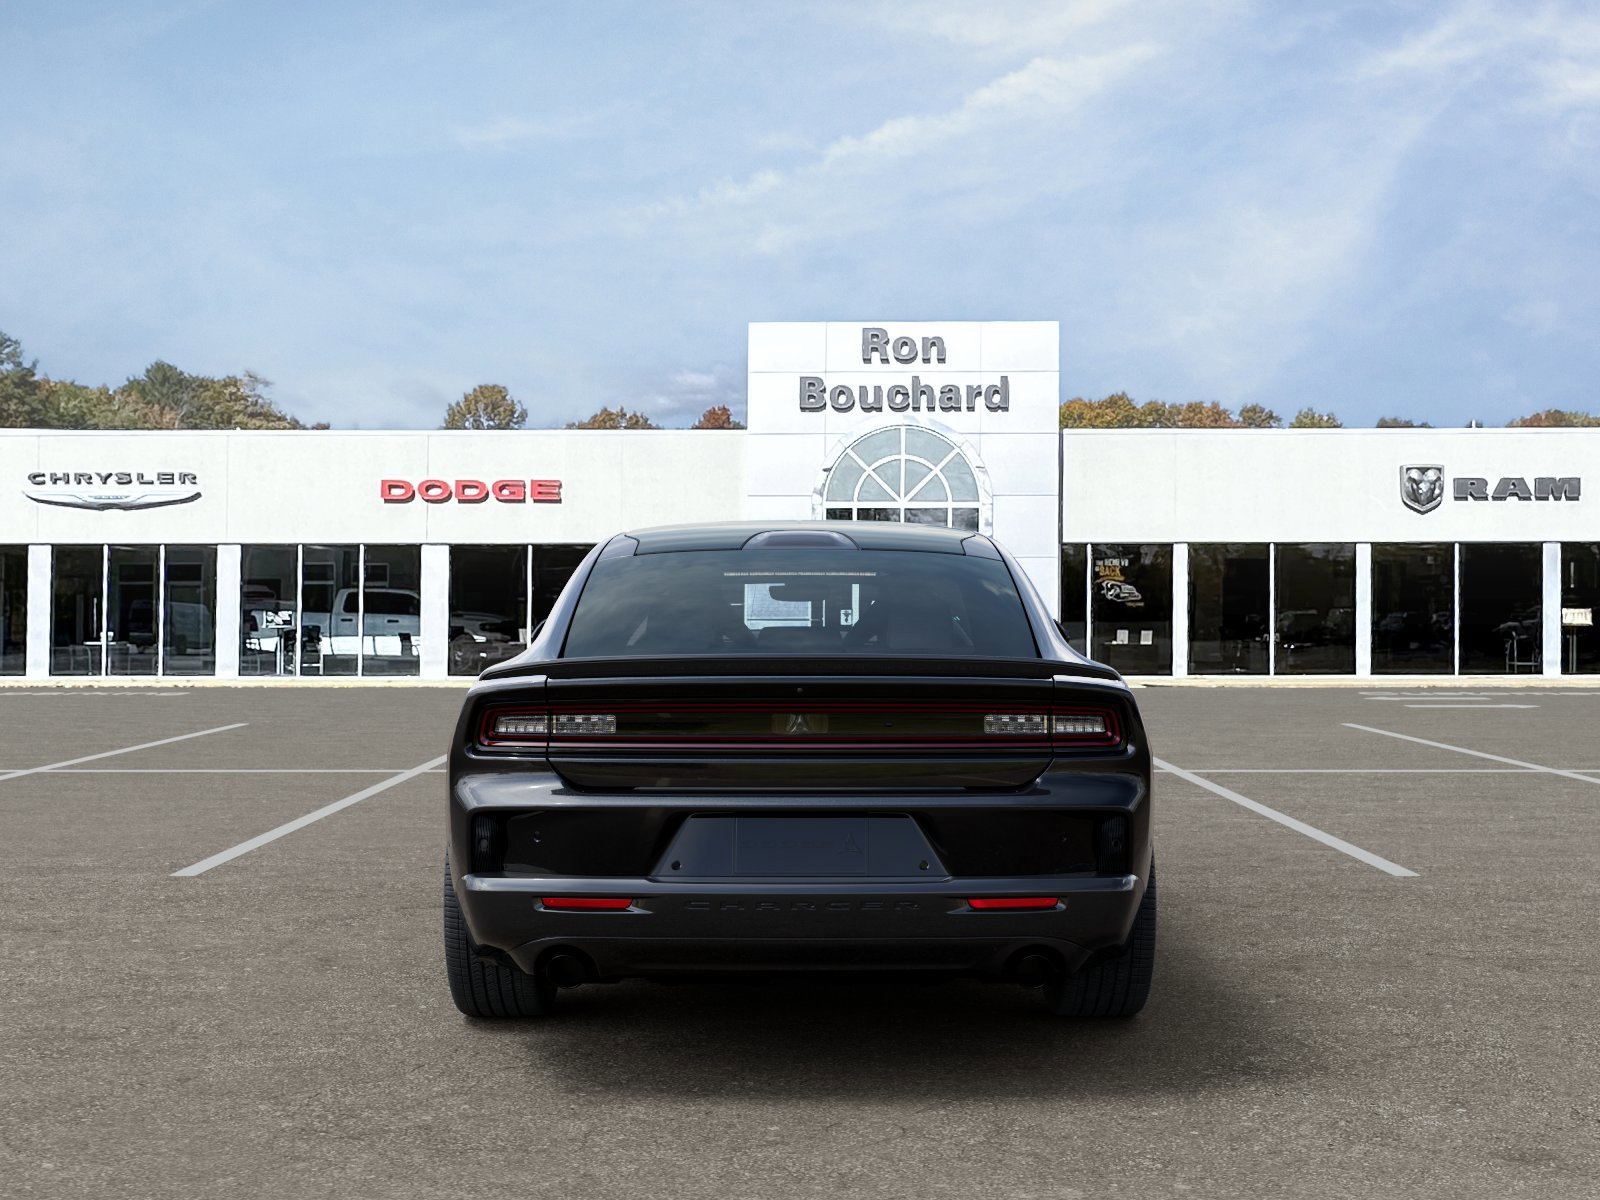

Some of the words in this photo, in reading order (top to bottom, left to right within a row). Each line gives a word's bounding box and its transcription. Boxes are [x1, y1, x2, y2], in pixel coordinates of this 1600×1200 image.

[862, 327, 947, 365] Ron
[799, 376, 1010, 413] Bouchard
[27, 472, 198, 486] CHRYSLER
[381, 479, 562, 504] DODGE
[1453, 477, 1581, 501] RAM
